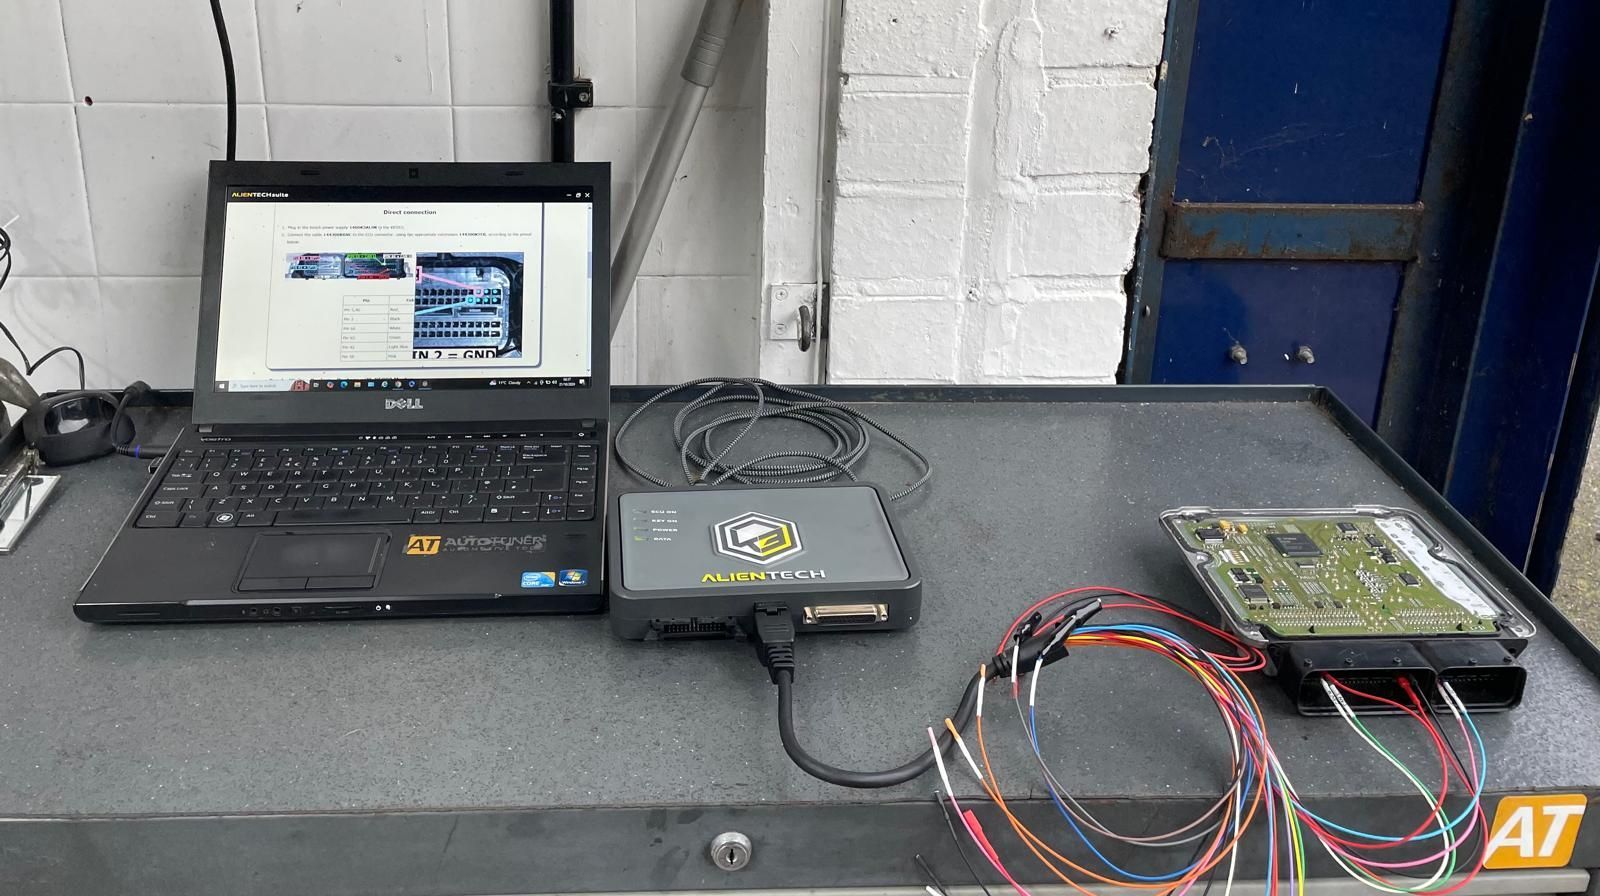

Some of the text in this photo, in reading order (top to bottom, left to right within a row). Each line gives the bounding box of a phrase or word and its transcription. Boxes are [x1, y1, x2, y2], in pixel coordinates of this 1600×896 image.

[464, 349, 497, 358] GND
[385, 398, 424, 410] DELL
[407, 538, 441, 552] AT
[702, 570, 826, 583] ALIENTECH
[1484, 804, 1586, 866] AT
